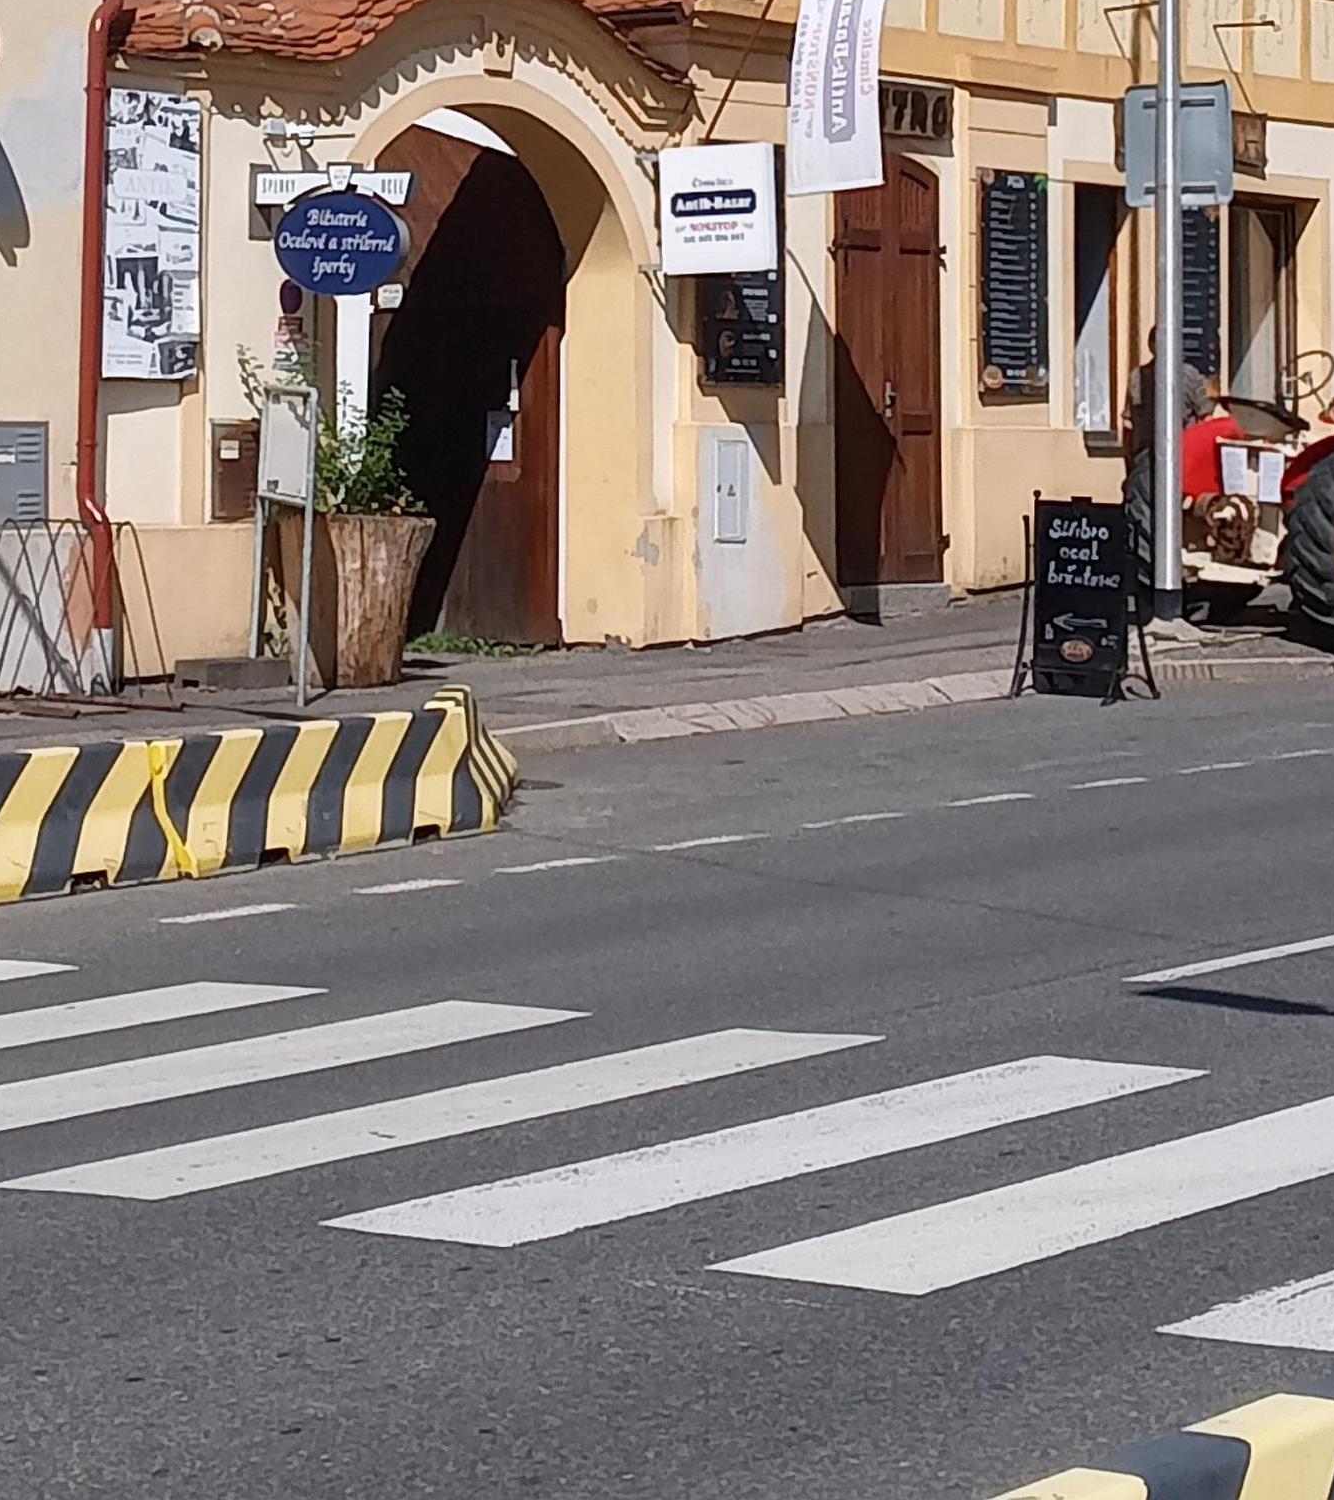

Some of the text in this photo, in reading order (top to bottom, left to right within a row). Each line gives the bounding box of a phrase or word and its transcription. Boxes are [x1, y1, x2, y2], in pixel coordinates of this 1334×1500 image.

[882, 88, 948, 137] TRO
[675, 195, 752, 212] Antik-Bazar
[328, 237, 339, 250] a
